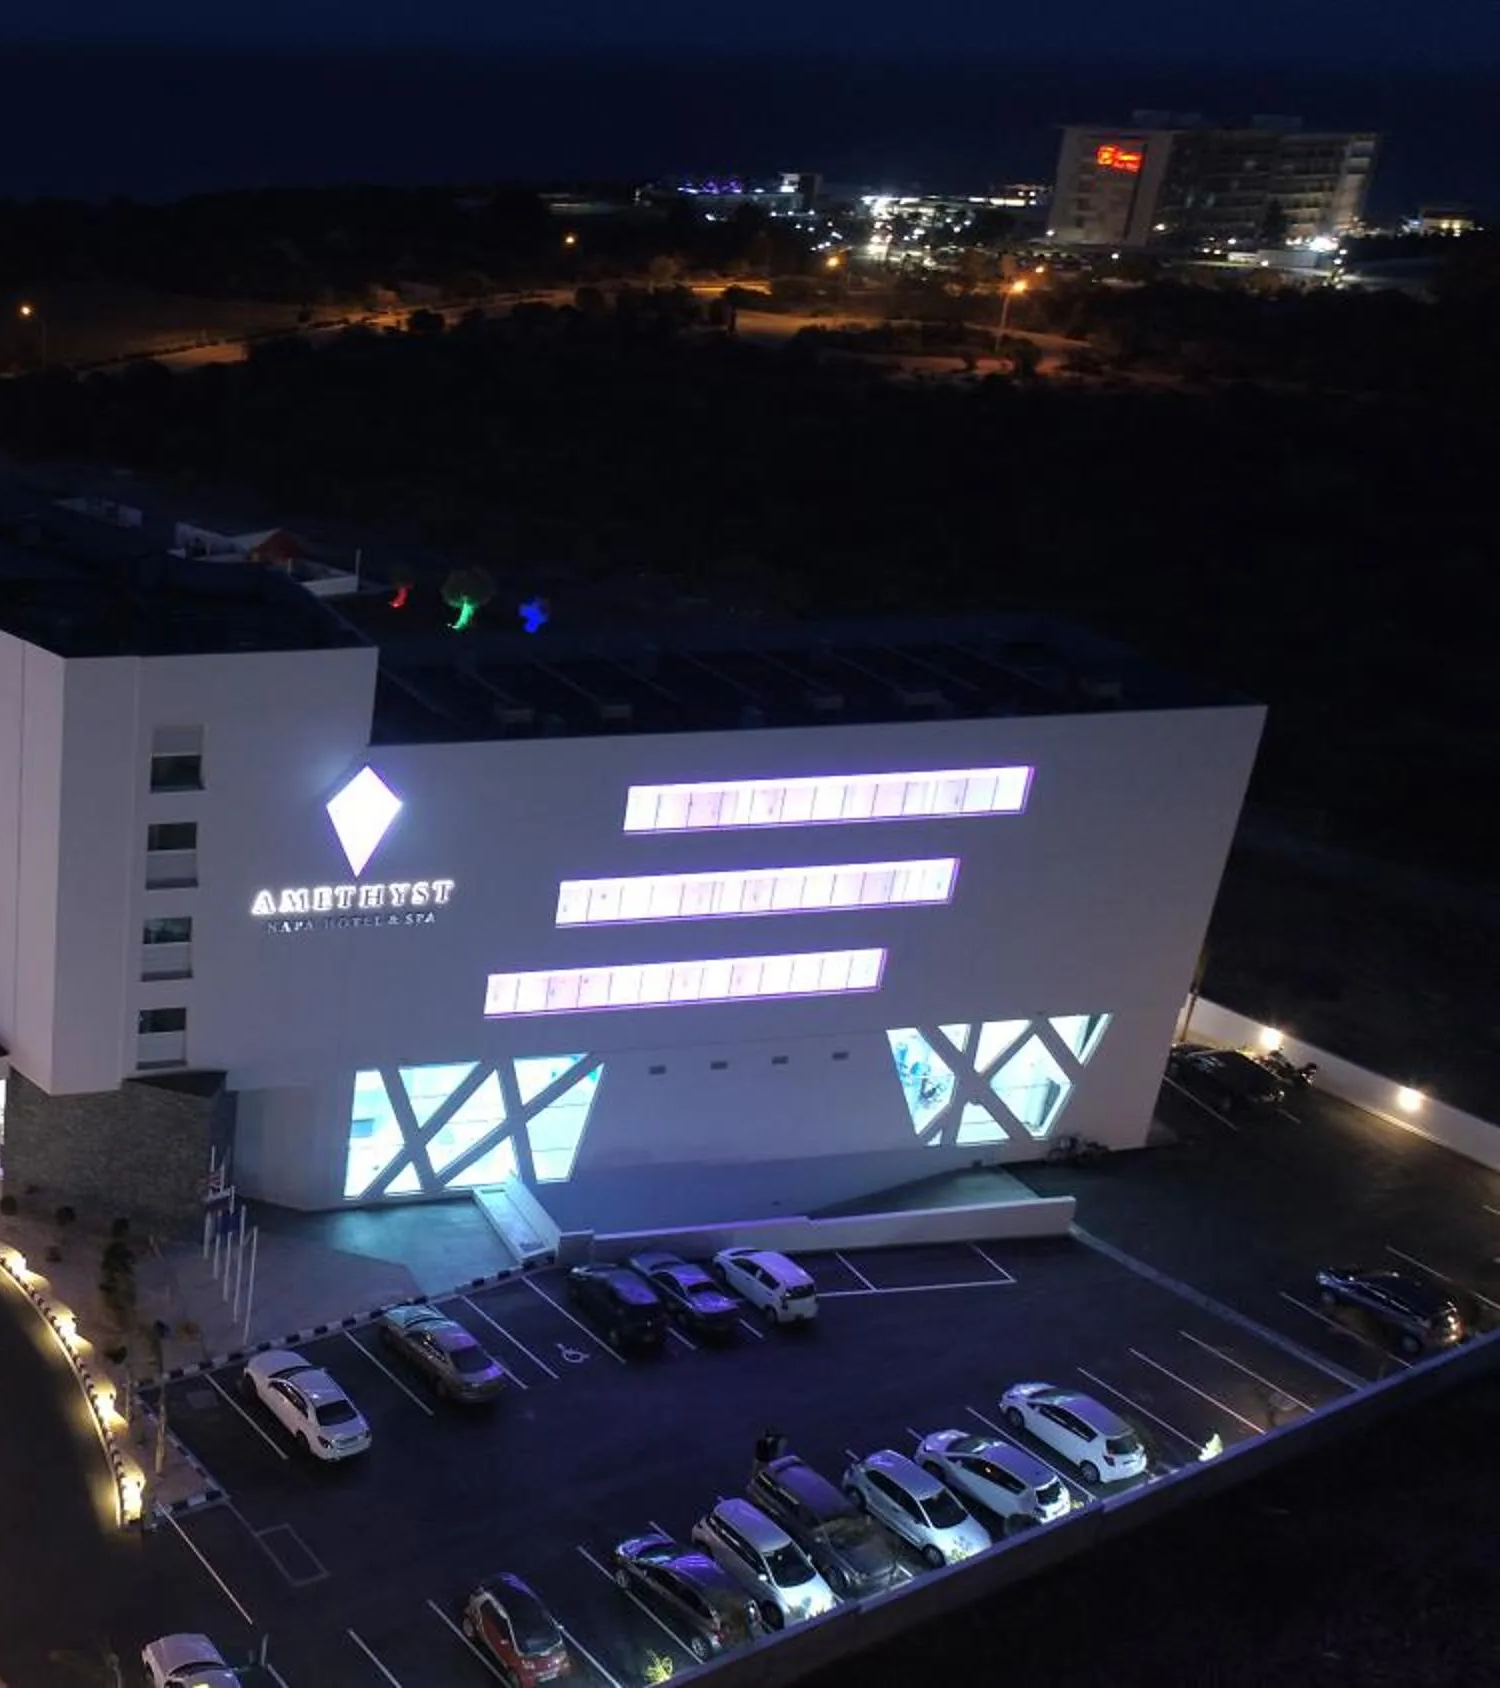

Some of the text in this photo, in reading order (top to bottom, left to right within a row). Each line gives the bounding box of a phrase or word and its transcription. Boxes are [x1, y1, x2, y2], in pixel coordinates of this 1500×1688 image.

[252, 880, 455, 914] AMETHYST
[267, 911, 436, 934] NAPA HOTEL & SPA
